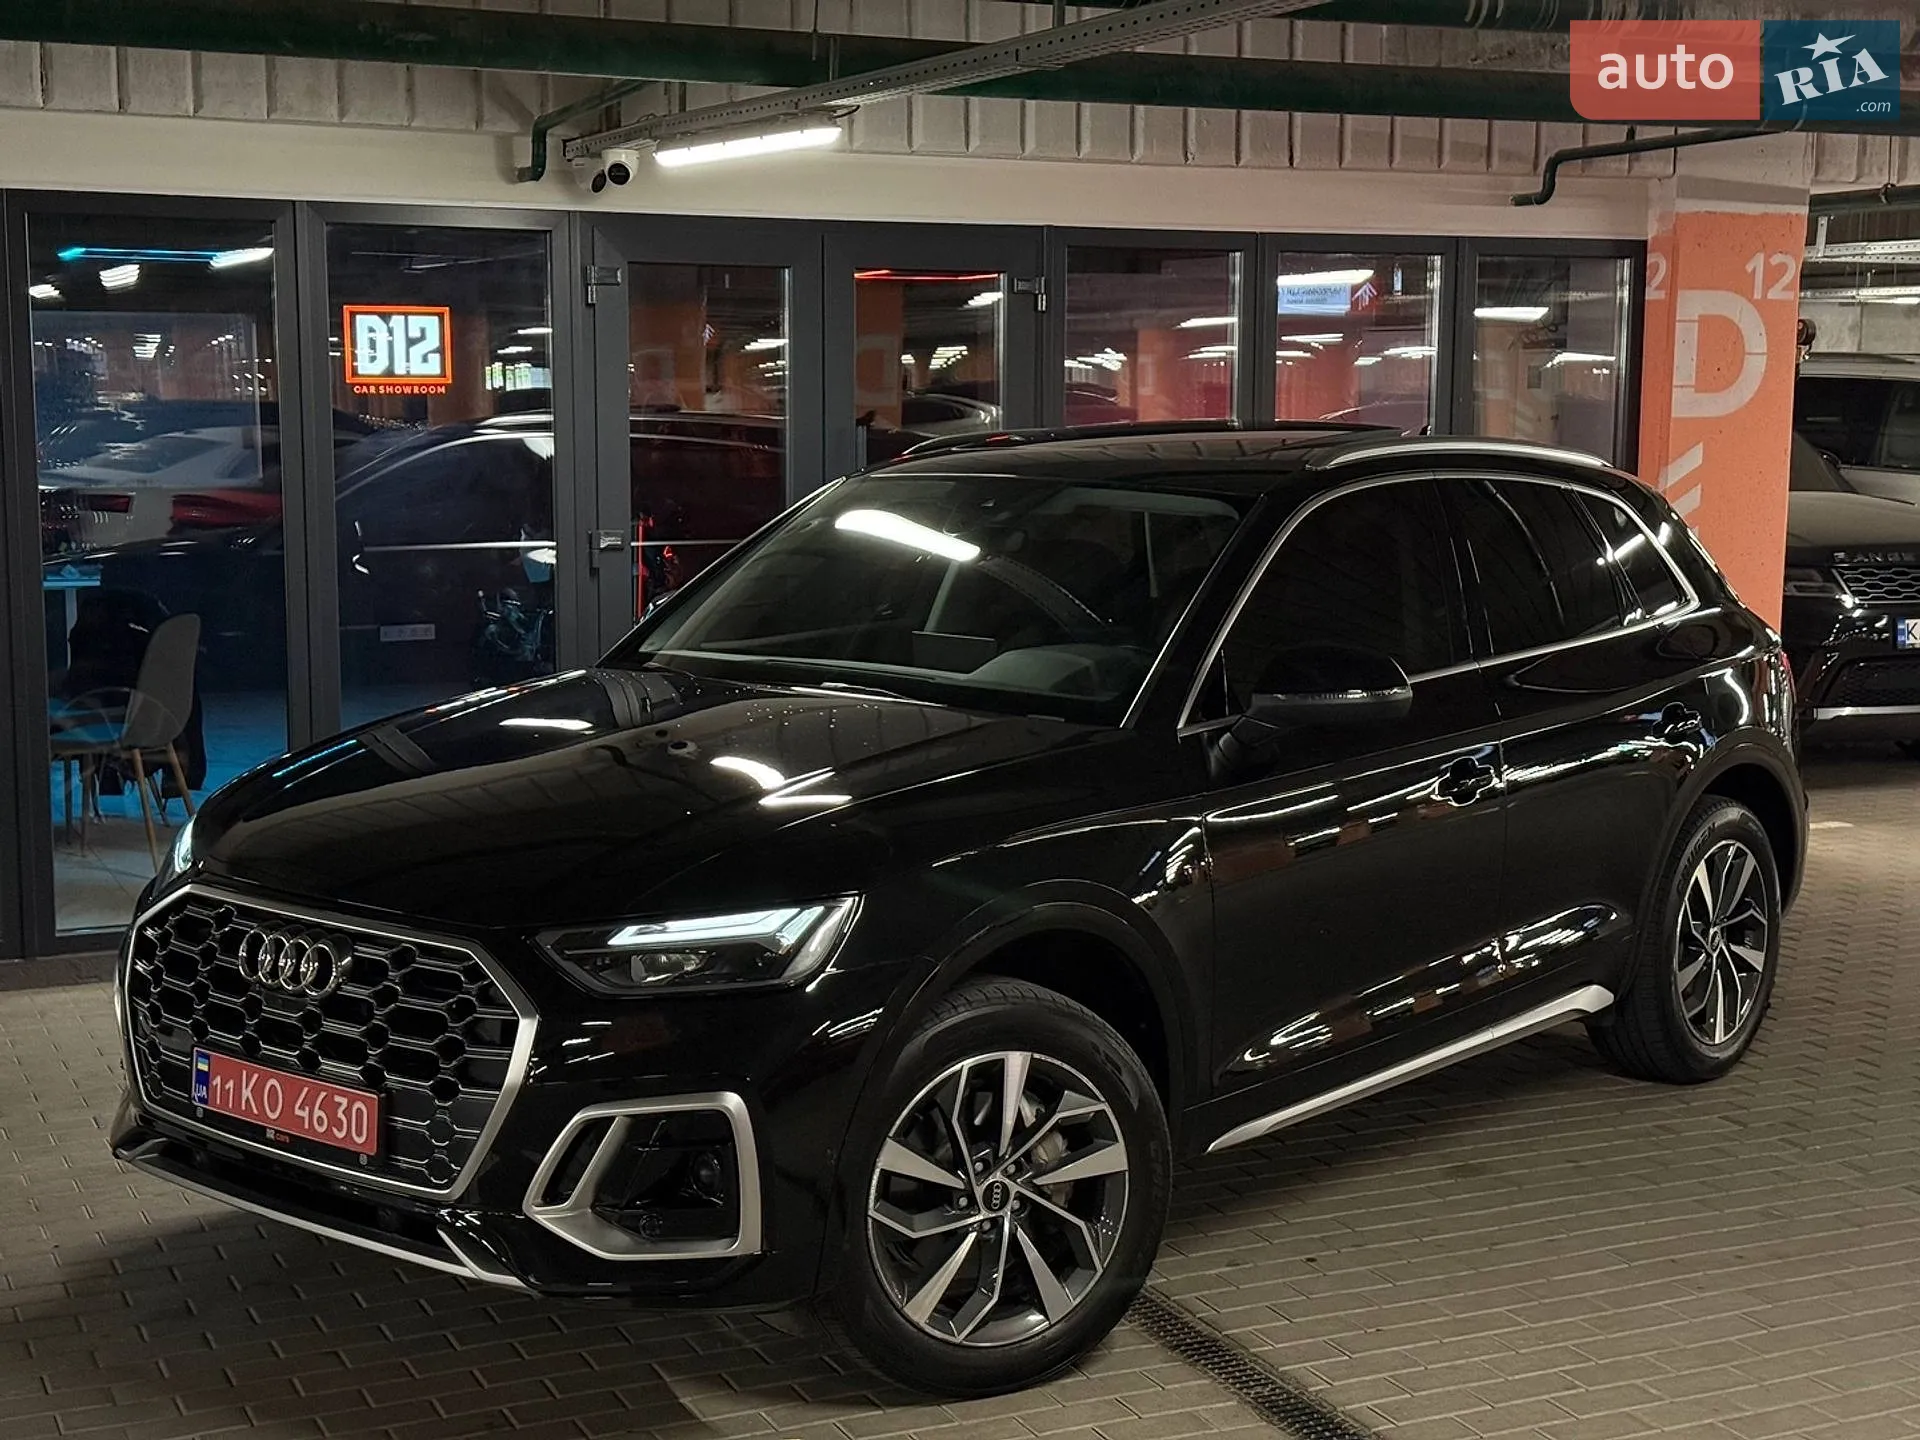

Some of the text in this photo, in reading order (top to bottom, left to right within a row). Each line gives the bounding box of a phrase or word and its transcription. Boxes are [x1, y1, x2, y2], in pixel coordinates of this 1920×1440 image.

[1745, 252, 1797, 300] 12
[355, 315, 441, 375] D12
[1672, 289, 1768, 418] D
[353, 385, 446, 394] CAR SHOWROOM
[1906, 621, 1920, 641] K
[194, 1083, 208, 1100] UA
[294, 1086, 368, 1145] 4630
